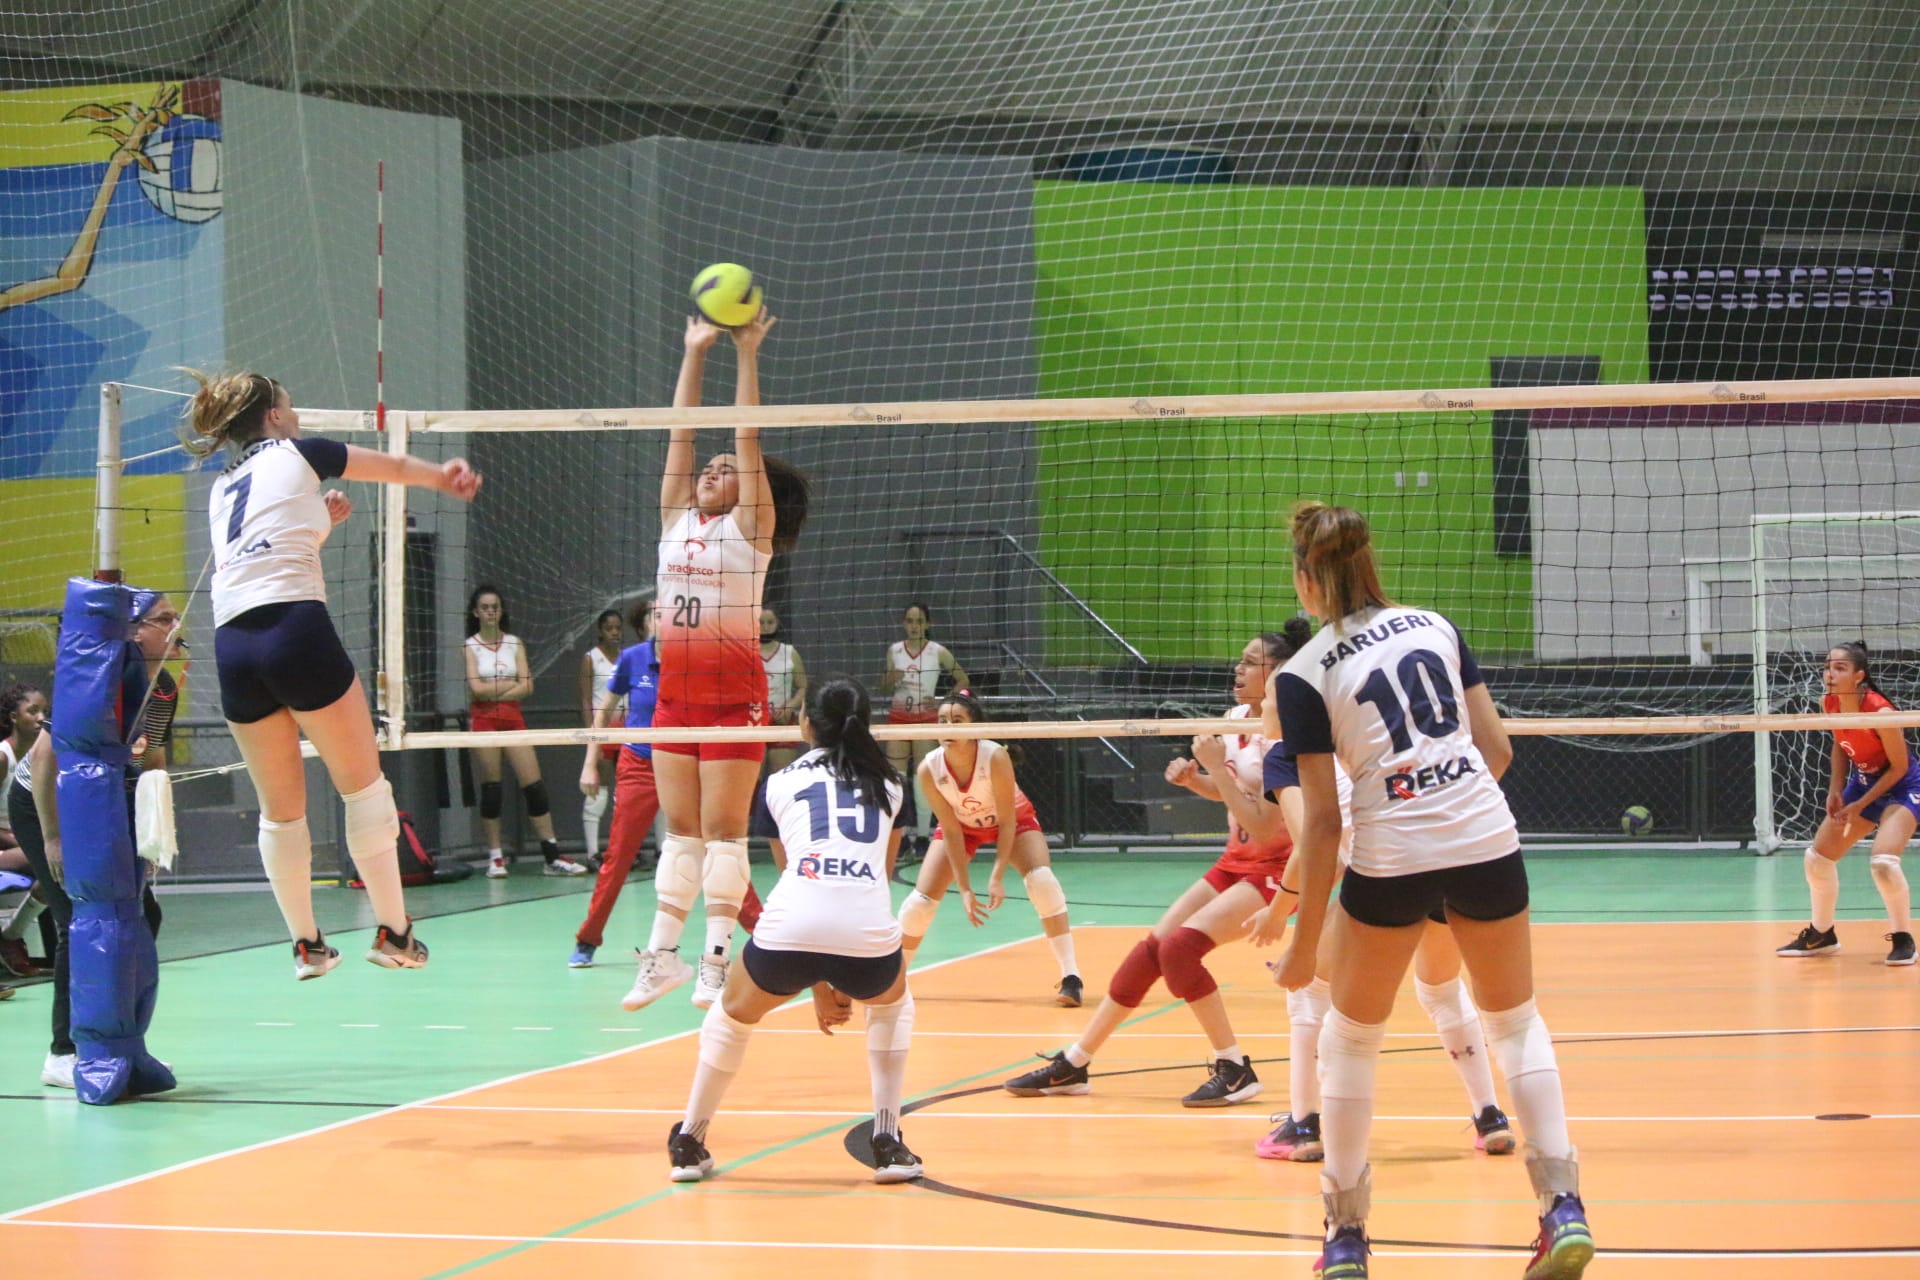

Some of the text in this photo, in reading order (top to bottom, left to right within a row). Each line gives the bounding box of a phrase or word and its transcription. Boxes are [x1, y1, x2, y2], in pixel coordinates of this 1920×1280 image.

[1447, 399, 1474, 408] Brasil
[1739, 392, 1766, 401] Brasil
[876, 413, 902, 423] Brasil
[1159, 407, 1185, 416] Brasil
[602, 419, 628, 428] Brasil
[223, 472, 253, 544] 7
[666, 563, 714, 577] bradesco
[672, 594, 701, 629] 20
[1319, 614, 1434, 671] BARUERI
[1355, 649, 1460, 755] 10
[794, 781, 880, 844] 15
